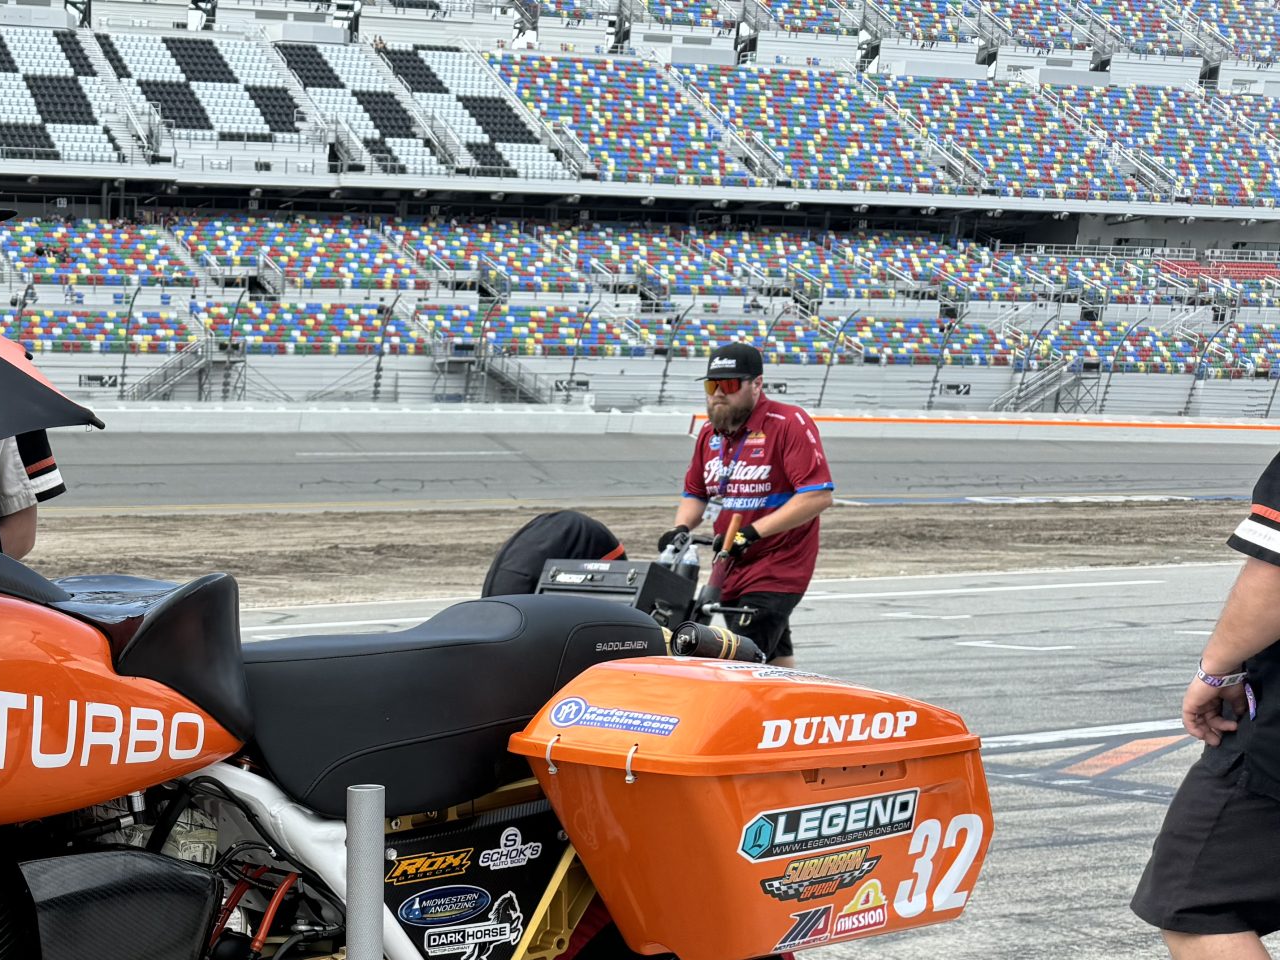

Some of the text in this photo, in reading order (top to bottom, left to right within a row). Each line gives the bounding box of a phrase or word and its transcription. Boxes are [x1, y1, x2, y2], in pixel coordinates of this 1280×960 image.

[740, 482, 772, 493] RACING
[595, 640, 649, 652] SADDLEMEN
[582, 713, 674, 731] Machine.com
[586, 706, 680, 724] Performance
[757, 711, 918, 749] DUNLOP
[773, 792, 918, 846] LEGEND
[503, 833, 518, 848] S
[772, 821, 912, 854] WWW.LEGENDSUSPENSIONS.COM
[480, 844, 540, 864] SCHOK'S
[492, 857, 527, 868] AUTO BODY
[391, 852, 468, 877] ROX
[783, 848, 870, 885] SUBURBAN
[893, 813, 984, 918] 32
[802, 877, 841, 899] SPEED
[421, 892, 480, 907] MIDWESTERN
[428, 901, 477, 914] ANODIZING
[430, 926, 508, 947] DARK HORSE
